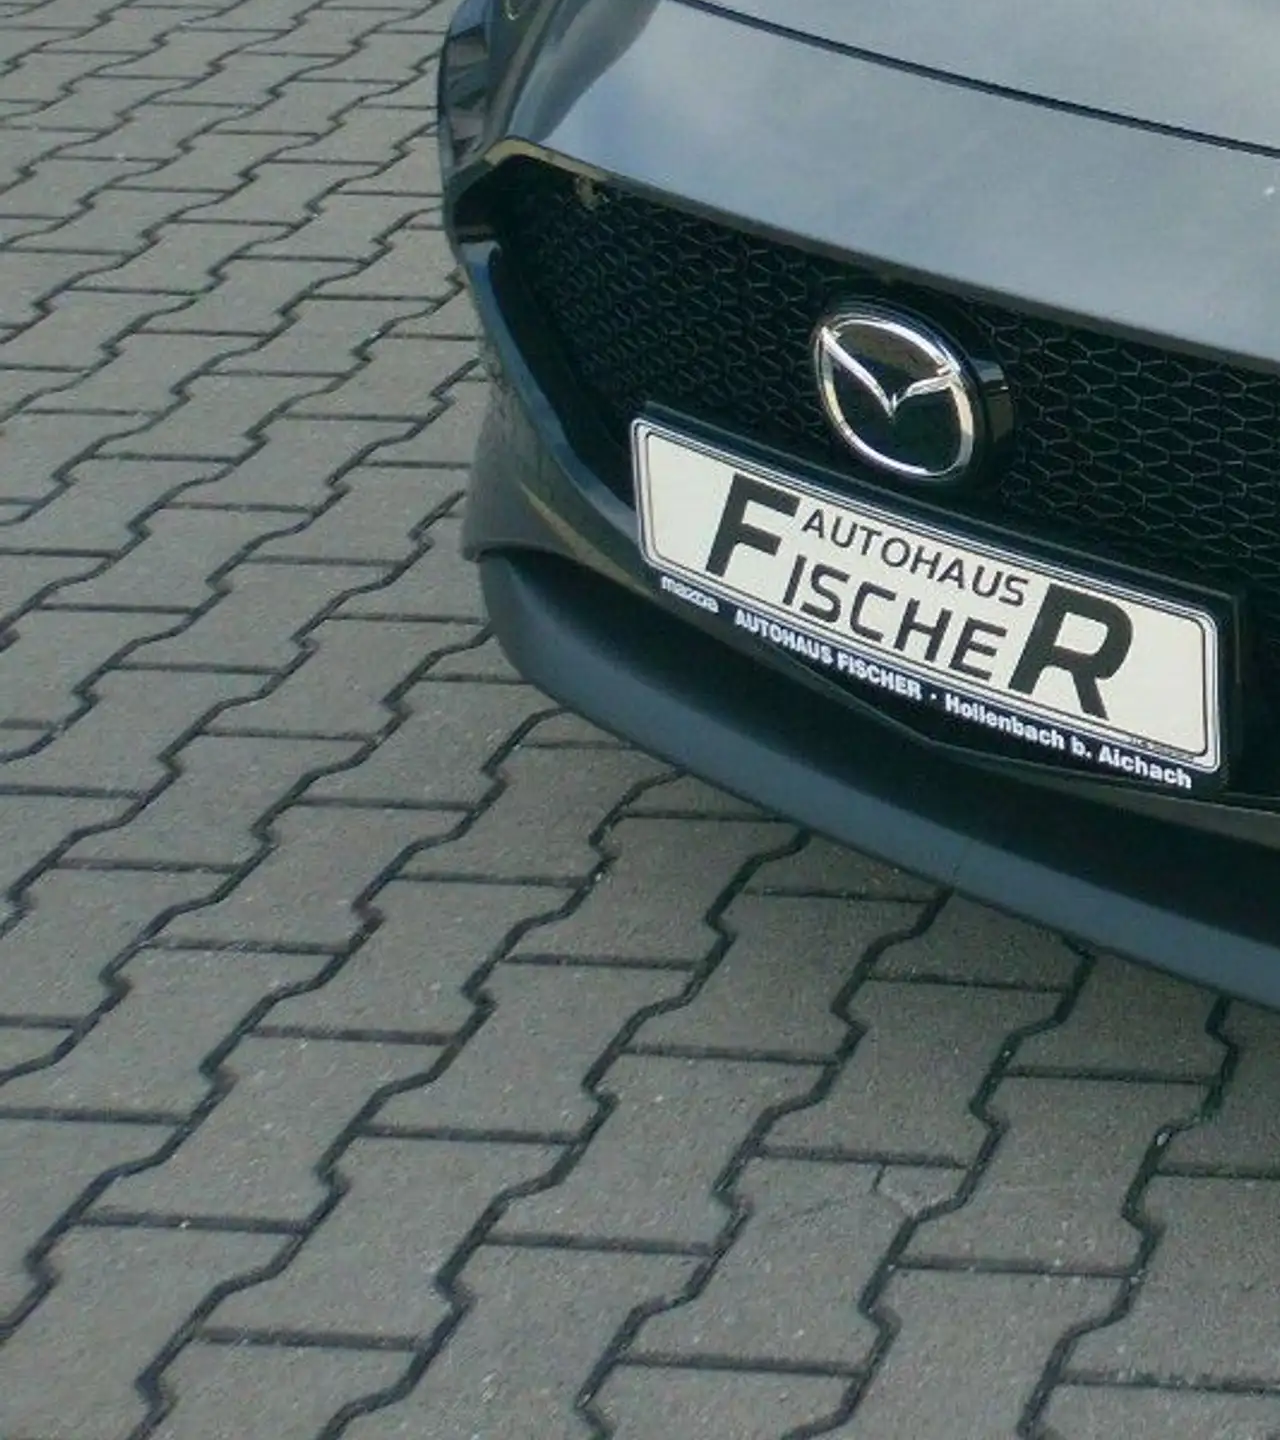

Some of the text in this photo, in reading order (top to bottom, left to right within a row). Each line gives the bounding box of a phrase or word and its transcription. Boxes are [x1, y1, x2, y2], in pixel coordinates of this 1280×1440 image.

[704, 472, 1134, 721] FISCHER
[801, 508, 1029, 607] AUTOHAUS
[660, 575, 719, 614] mazda
[733, 608, 834, 665] AUTOHAUS
[837, 649, 923, 702] FISCHER
[944, 692, 1066, 751] Hollenbach
[1070, 735, 1093, 759] b.
[1098, 744, 1193, 790] Aichach
